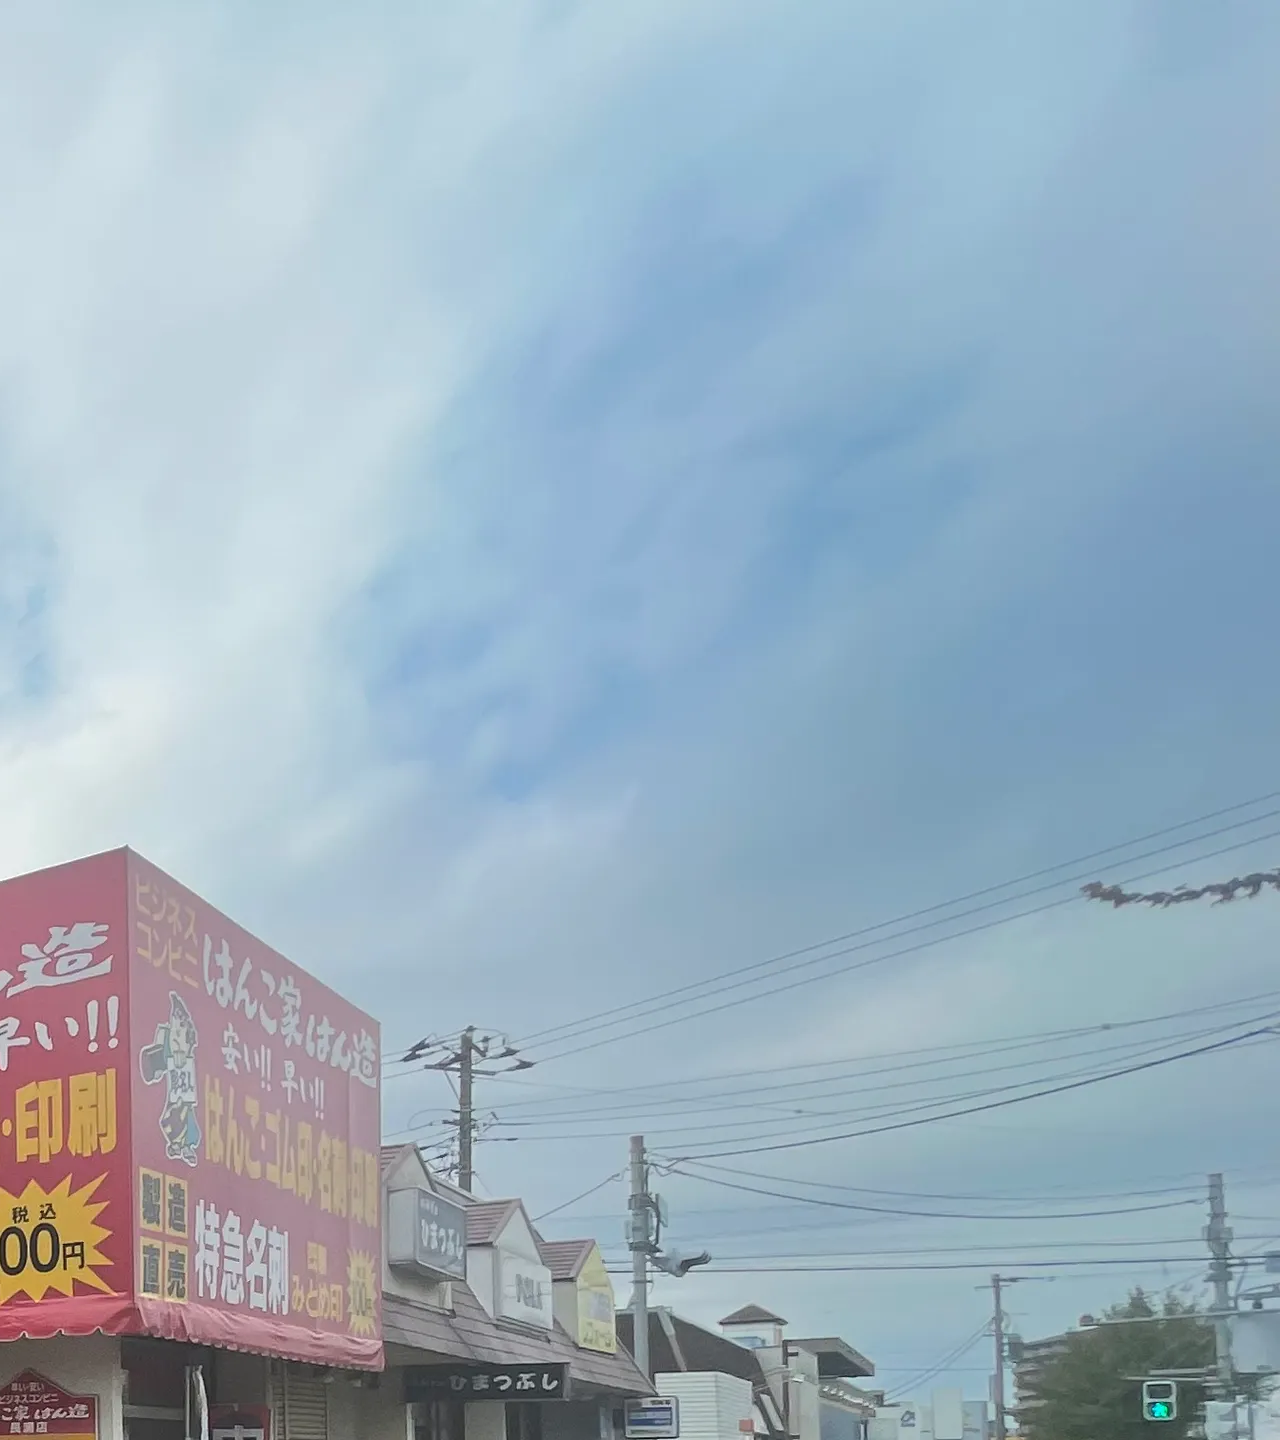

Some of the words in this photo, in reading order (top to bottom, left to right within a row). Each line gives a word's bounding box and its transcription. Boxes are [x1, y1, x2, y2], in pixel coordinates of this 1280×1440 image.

[136, 874, 198, 946] ビジネス
[136, 921, 199, 988] コンビニ
[11, 1202, 57, 1224] 税込
[421, 1218, 464, 1260] ひまつぶし
[195, 1198, 290, 1317] 特急名刺
[449, 1372, 559, 1391] ひまつぶし
